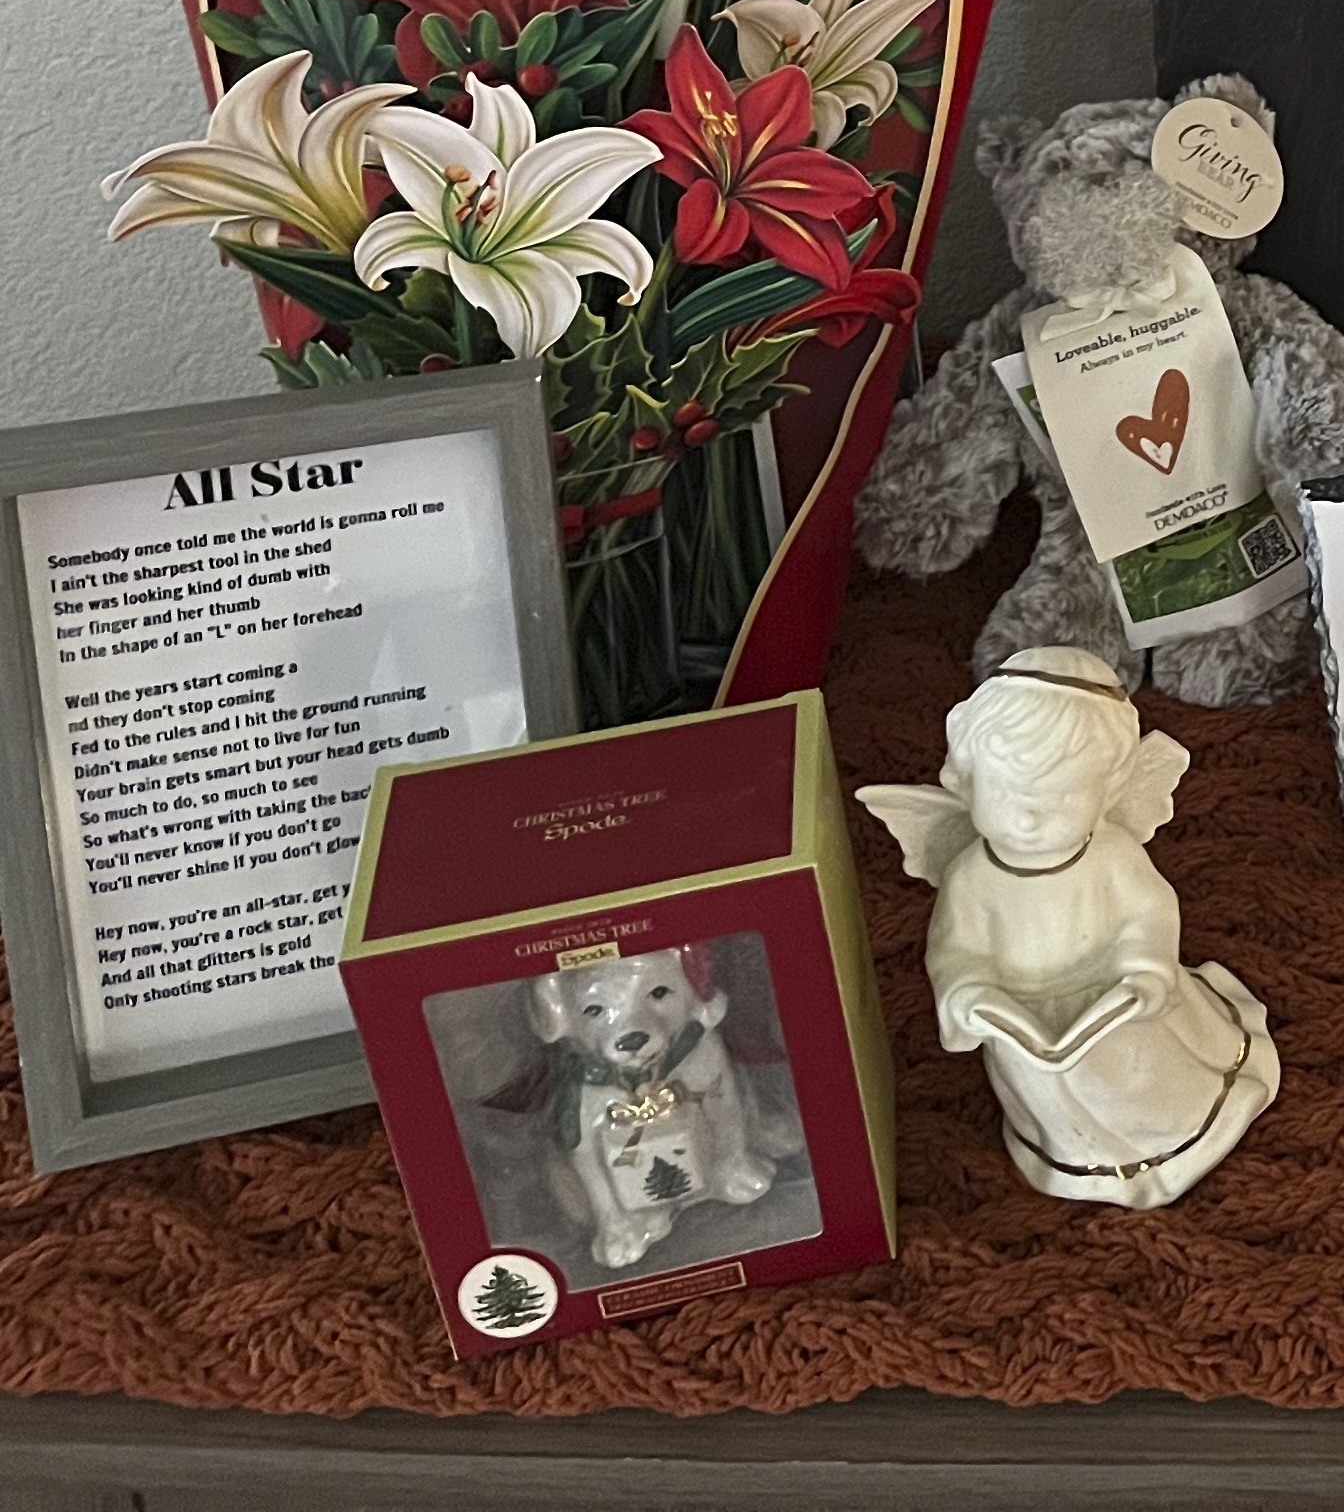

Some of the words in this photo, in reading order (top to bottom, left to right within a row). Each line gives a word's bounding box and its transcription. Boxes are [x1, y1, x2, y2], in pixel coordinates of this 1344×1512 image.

[1179, 124, 1263, 203] Giving
[1055, 332, 1127, 363] Loveable,
[1080, 353, 1120, 373] Always
[1136, 341, 1154, 355] my
[164, 467, 236, 510] All
[251, 458, 363, 497] Star
[47, 546, 129, 569] Somebody
[134, 541, 171, 556] once
[176, 533, 207, 550] told
[212, 532, 235, 545] me
[240, 525, 267, 541] the
[271, 517, 315, 536] world
[320, 515, 333, 529] is
[338, 510, 386, 529] gonna
[390, 502, 417, 518] roll
[422, 501, 444, 513] me
[52, 601, 83, 616] She
[88, 596, 119, 610] was
[122, 586, 183, 605] looking
[187, 577, 222, 595] kind
[226, 574, 242, 589] of
[247, 567, 291, 586] dumb
[295, 563, 330, 579] with
[61, 574, 97, 591] ain't
[102, 571, 128, 585] the
[133, 558, 204, 581] sharpest
[208, 552, 239, 569] tool
[243, 549, 259, 564] in
[263, 547, 289, 561] the
[294, 538, 331, 556] shed
[56, 625, 84, 639] her
[88, 617, 138, 635] finger
[142, 609, 172, 626] and
[176, 607, 204, 621] her
[208, 596, 260, 616] thumb
[64, 691, 99, 709] Well
[104, 689, 130, 703] the
[135, 681, 178, 701] years
[182, 672, 223, 690] start
[226, 663, 284, 683] coming
[71, 739, 98, 756] Fed
[103, 738, 120, 751] to
[124, 733, 151, 747] the
[155, 725, 197, 742] rules
[201, 717, 230, 734] and
[244, 711, 267, 727] hit
[271, 708, 297, 722] the
[302, 695, 358, 720] ground
[363, 685, 426, 706] running
[73, 760, 122, 780] Didn't
[126, 753, 167, 771] make
[172, 745, 217, 763] sense
[222, 738, 249, 754] not
[253, 736, 269, 749] to
[273, 730, 301, 745] live
[305, 725, 329, 739] for
[333, 721, 360, 735] fun
[84, 852, 129, 872] You'll
[133, 845, 178, 864] never
[182, 838, 224, 855] know
[228, 831, 240, 846] if
[244, 829, 272, 846] you
[277, 818, 317, 837] don't
[322, 816, 341, 832] go
[100, 968, 131, 987] And
[136, 964, 155, 980] all
[159, 958, 192, 976] that
[197, 948, 255, 971] glitters
[260, 942, 273, 956] is
[278, 933, 311, 955] gold
[515, 928, 607, 957] CHRISTMAS
[612, 919, 654, 938] TREE
[103, 993, 138, 1009] Only
[142, 979, 212, 1002] shooting
[216, 971, 256, 988] stars
[260, 959, 305, 979] break
[309, 955, 334, 969] the
